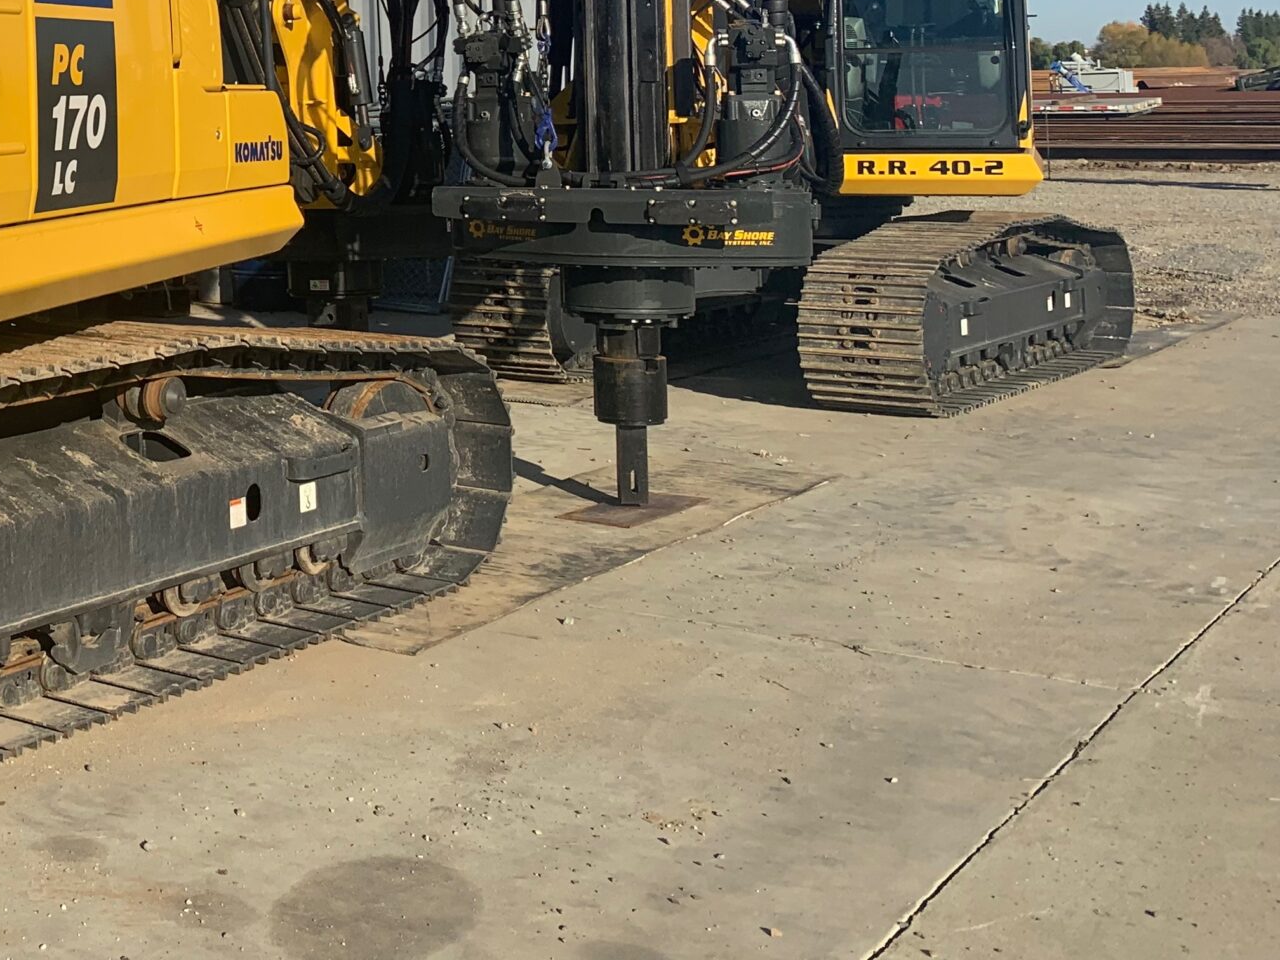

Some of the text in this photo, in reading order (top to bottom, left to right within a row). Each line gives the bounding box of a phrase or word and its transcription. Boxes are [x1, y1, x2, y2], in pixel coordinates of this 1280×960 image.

[51, 43, 85, 86] PC
[52, 93, 107, 152] 170
[235, 135, 283, 163] KOMATSU
[51, 159, 78, 196] LC
[857, 160, 1004, 176] R.R. 40-2
